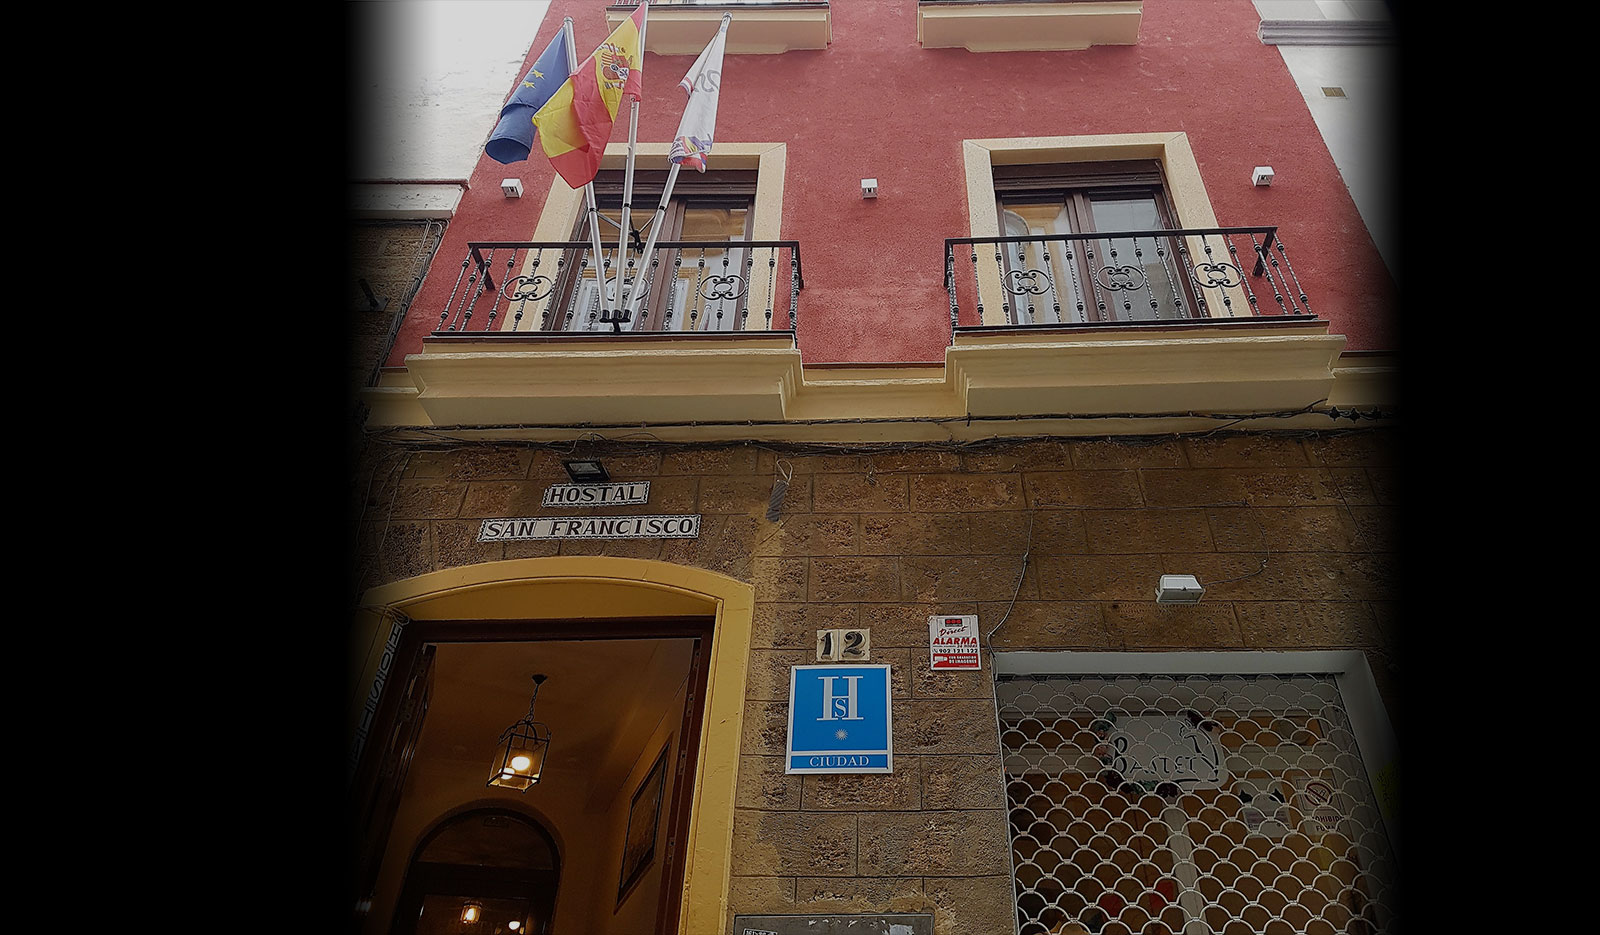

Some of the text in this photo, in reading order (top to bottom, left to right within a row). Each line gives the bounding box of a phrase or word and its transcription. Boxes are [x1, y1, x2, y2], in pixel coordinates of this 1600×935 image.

[549, 486, 642, 503] HOSTAL
[485, 519, 694, 538] SAN FRANCISCO
[939, 626, 968, 636] Direct
[820, 630, 866, 660] 12
[933, 637, 977, 645] ALARMA
[809, 755, 870, 768] CIUDAD
